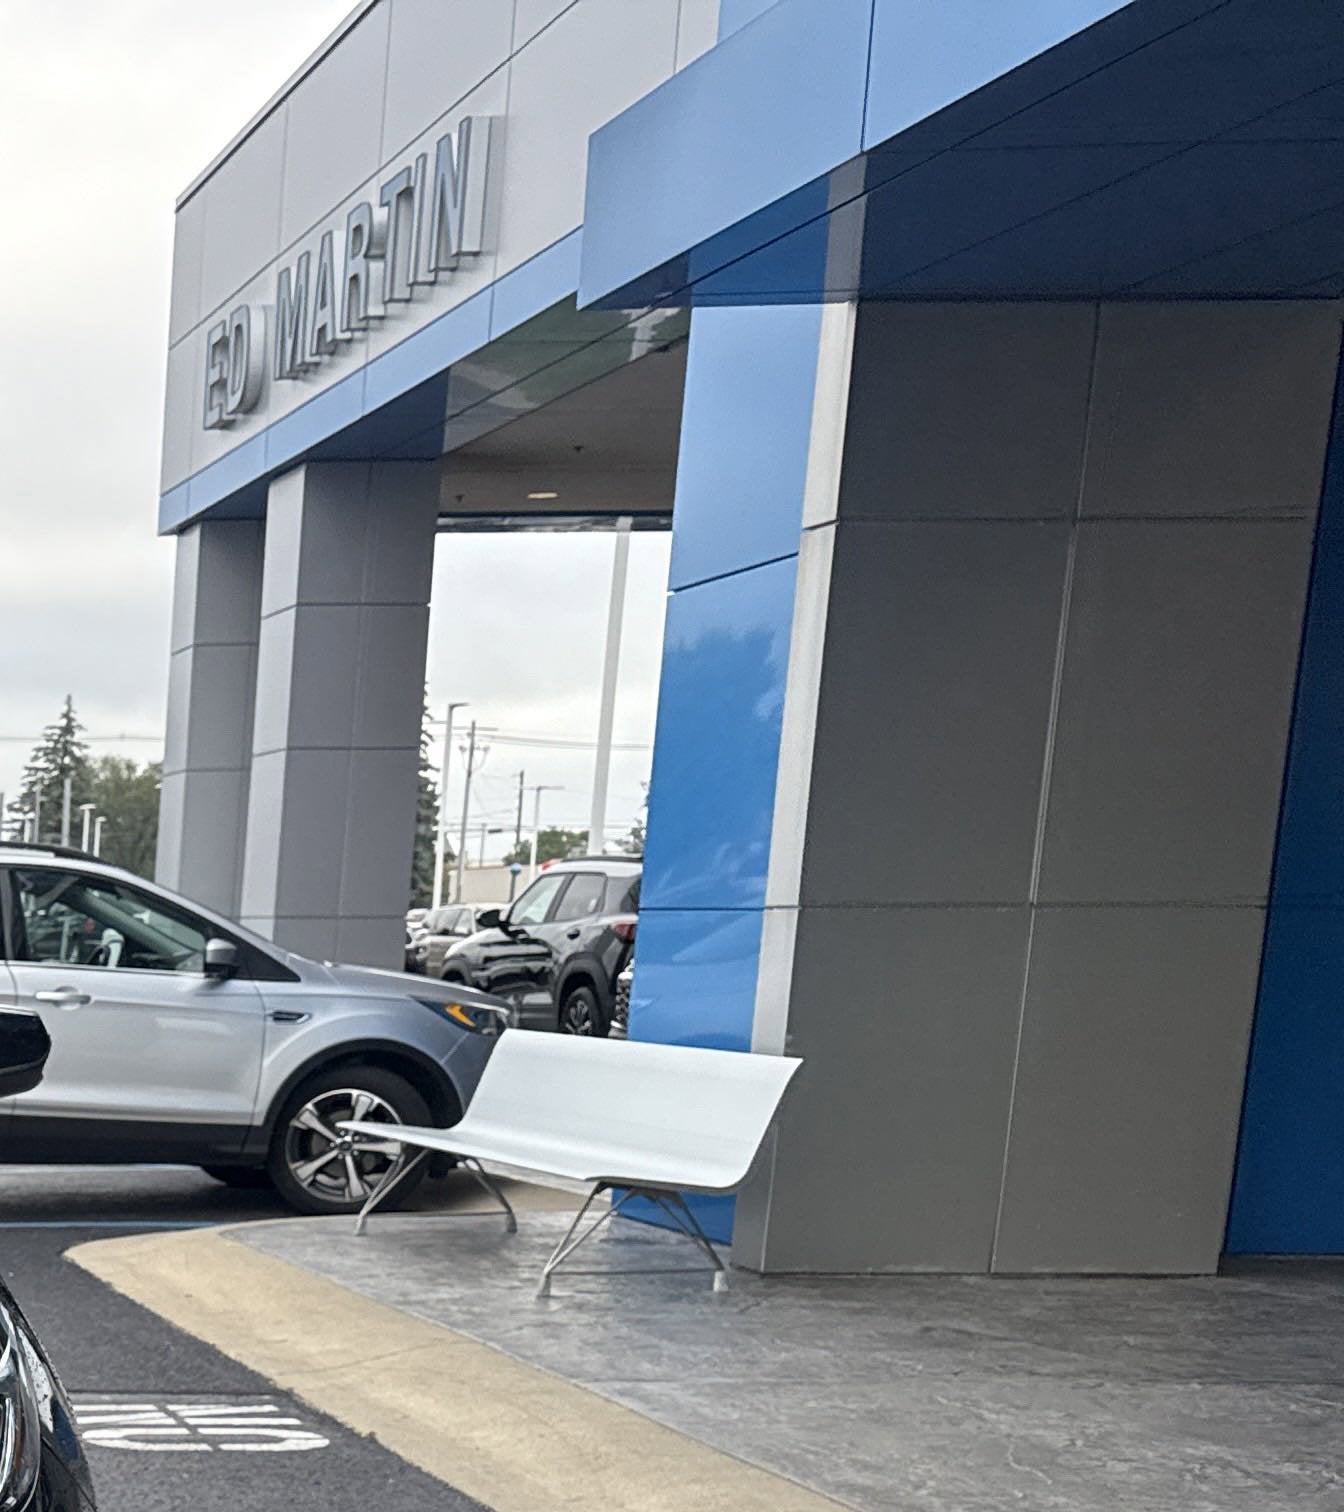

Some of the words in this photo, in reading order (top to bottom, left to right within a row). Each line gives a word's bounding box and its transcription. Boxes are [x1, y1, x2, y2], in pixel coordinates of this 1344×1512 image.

[203, 303, 268, 431] ED
[274, 115, 494, 382] MARTIN
[72, 1402, 330, 1451] NO
